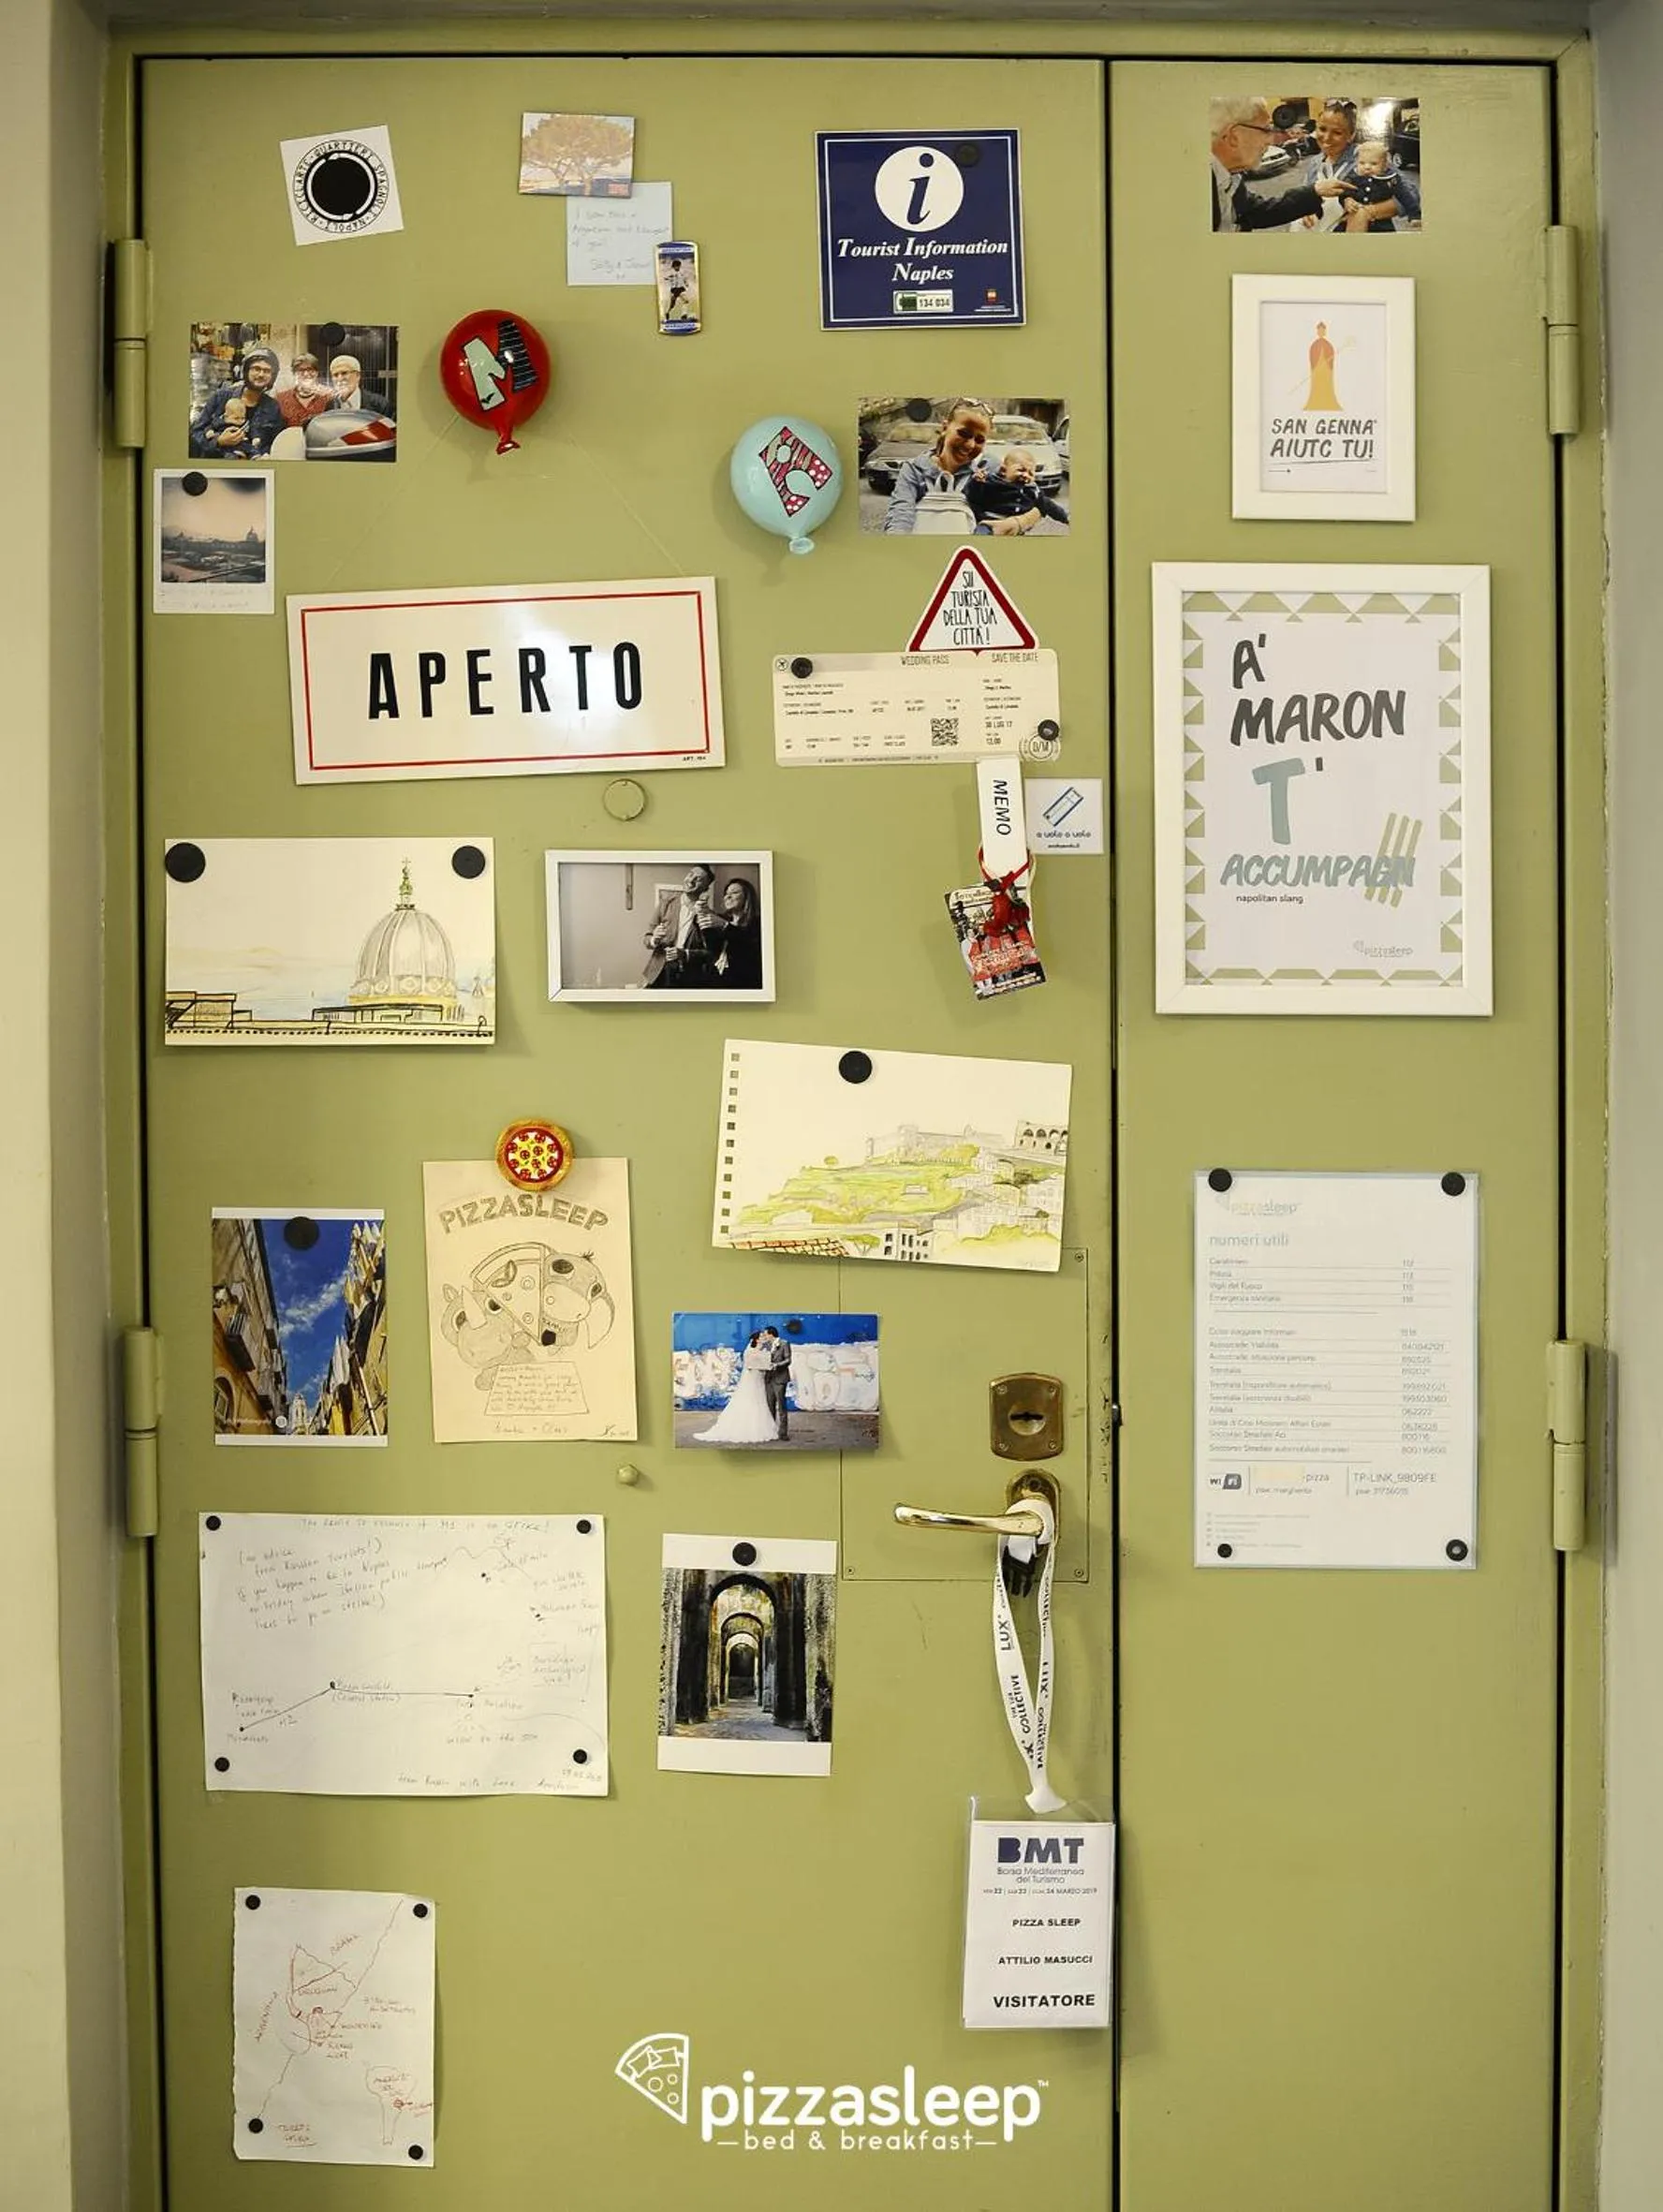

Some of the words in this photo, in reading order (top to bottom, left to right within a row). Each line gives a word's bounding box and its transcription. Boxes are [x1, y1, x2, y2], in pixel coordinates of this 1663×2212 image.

[837, 239, 900, 258] Tourist
[903, 237, 1008, 258] Information
[891, 263, 953, 285] Naples
[1272, 419, 1307, 435] SAN
[1342, 438, 1374, 459] TU!
[950, 590, 990, 608] TURISTA
[943, 609, 973, 627] DELLA
[974, 607, 997, 626] TUA
[902, 656, 931, 666] WEDDING
[932, 655, 949, 665] PASS
[992, 653, 1008, 663] SAVE
[1023, 652, 1038, 662] DATE
[368, 641, 642, 719] APERTO
[1229, 689, 1406, 746] MARON
[993, 779, 1012, 836] MEMO
[1220, 853, 1417, 889] ACCUMPAGN
[1236, 893, 1277, 904] napolitan
[1279, 893, 1303, 905] slang
[439, 1193, 609, 1235] PIZZASLEEP
[1209, 1233, 1258, 1246] numeri
[1263, 1231, 1289, 1246] utili
[997, 1836, 1084, 1864] BMT
[996, 1866, 1023, 1875] Borsa
[1023, 1866, 1084, 1876] Mediterranea
[1016, 1876, 1031, 1884] del
[1032, 1876, 1066, 1884] Turismo
[1012, 1919, 1044, 1927] PIZZA
[1047, 1918, 1081, 1926] SLEEP
[997, 1956, 1040, 1966] ATTILIO
[1044, 1955, 1093, 1965] MASUCCI
[993, 1994, 1095, 2008] VISITATORE
